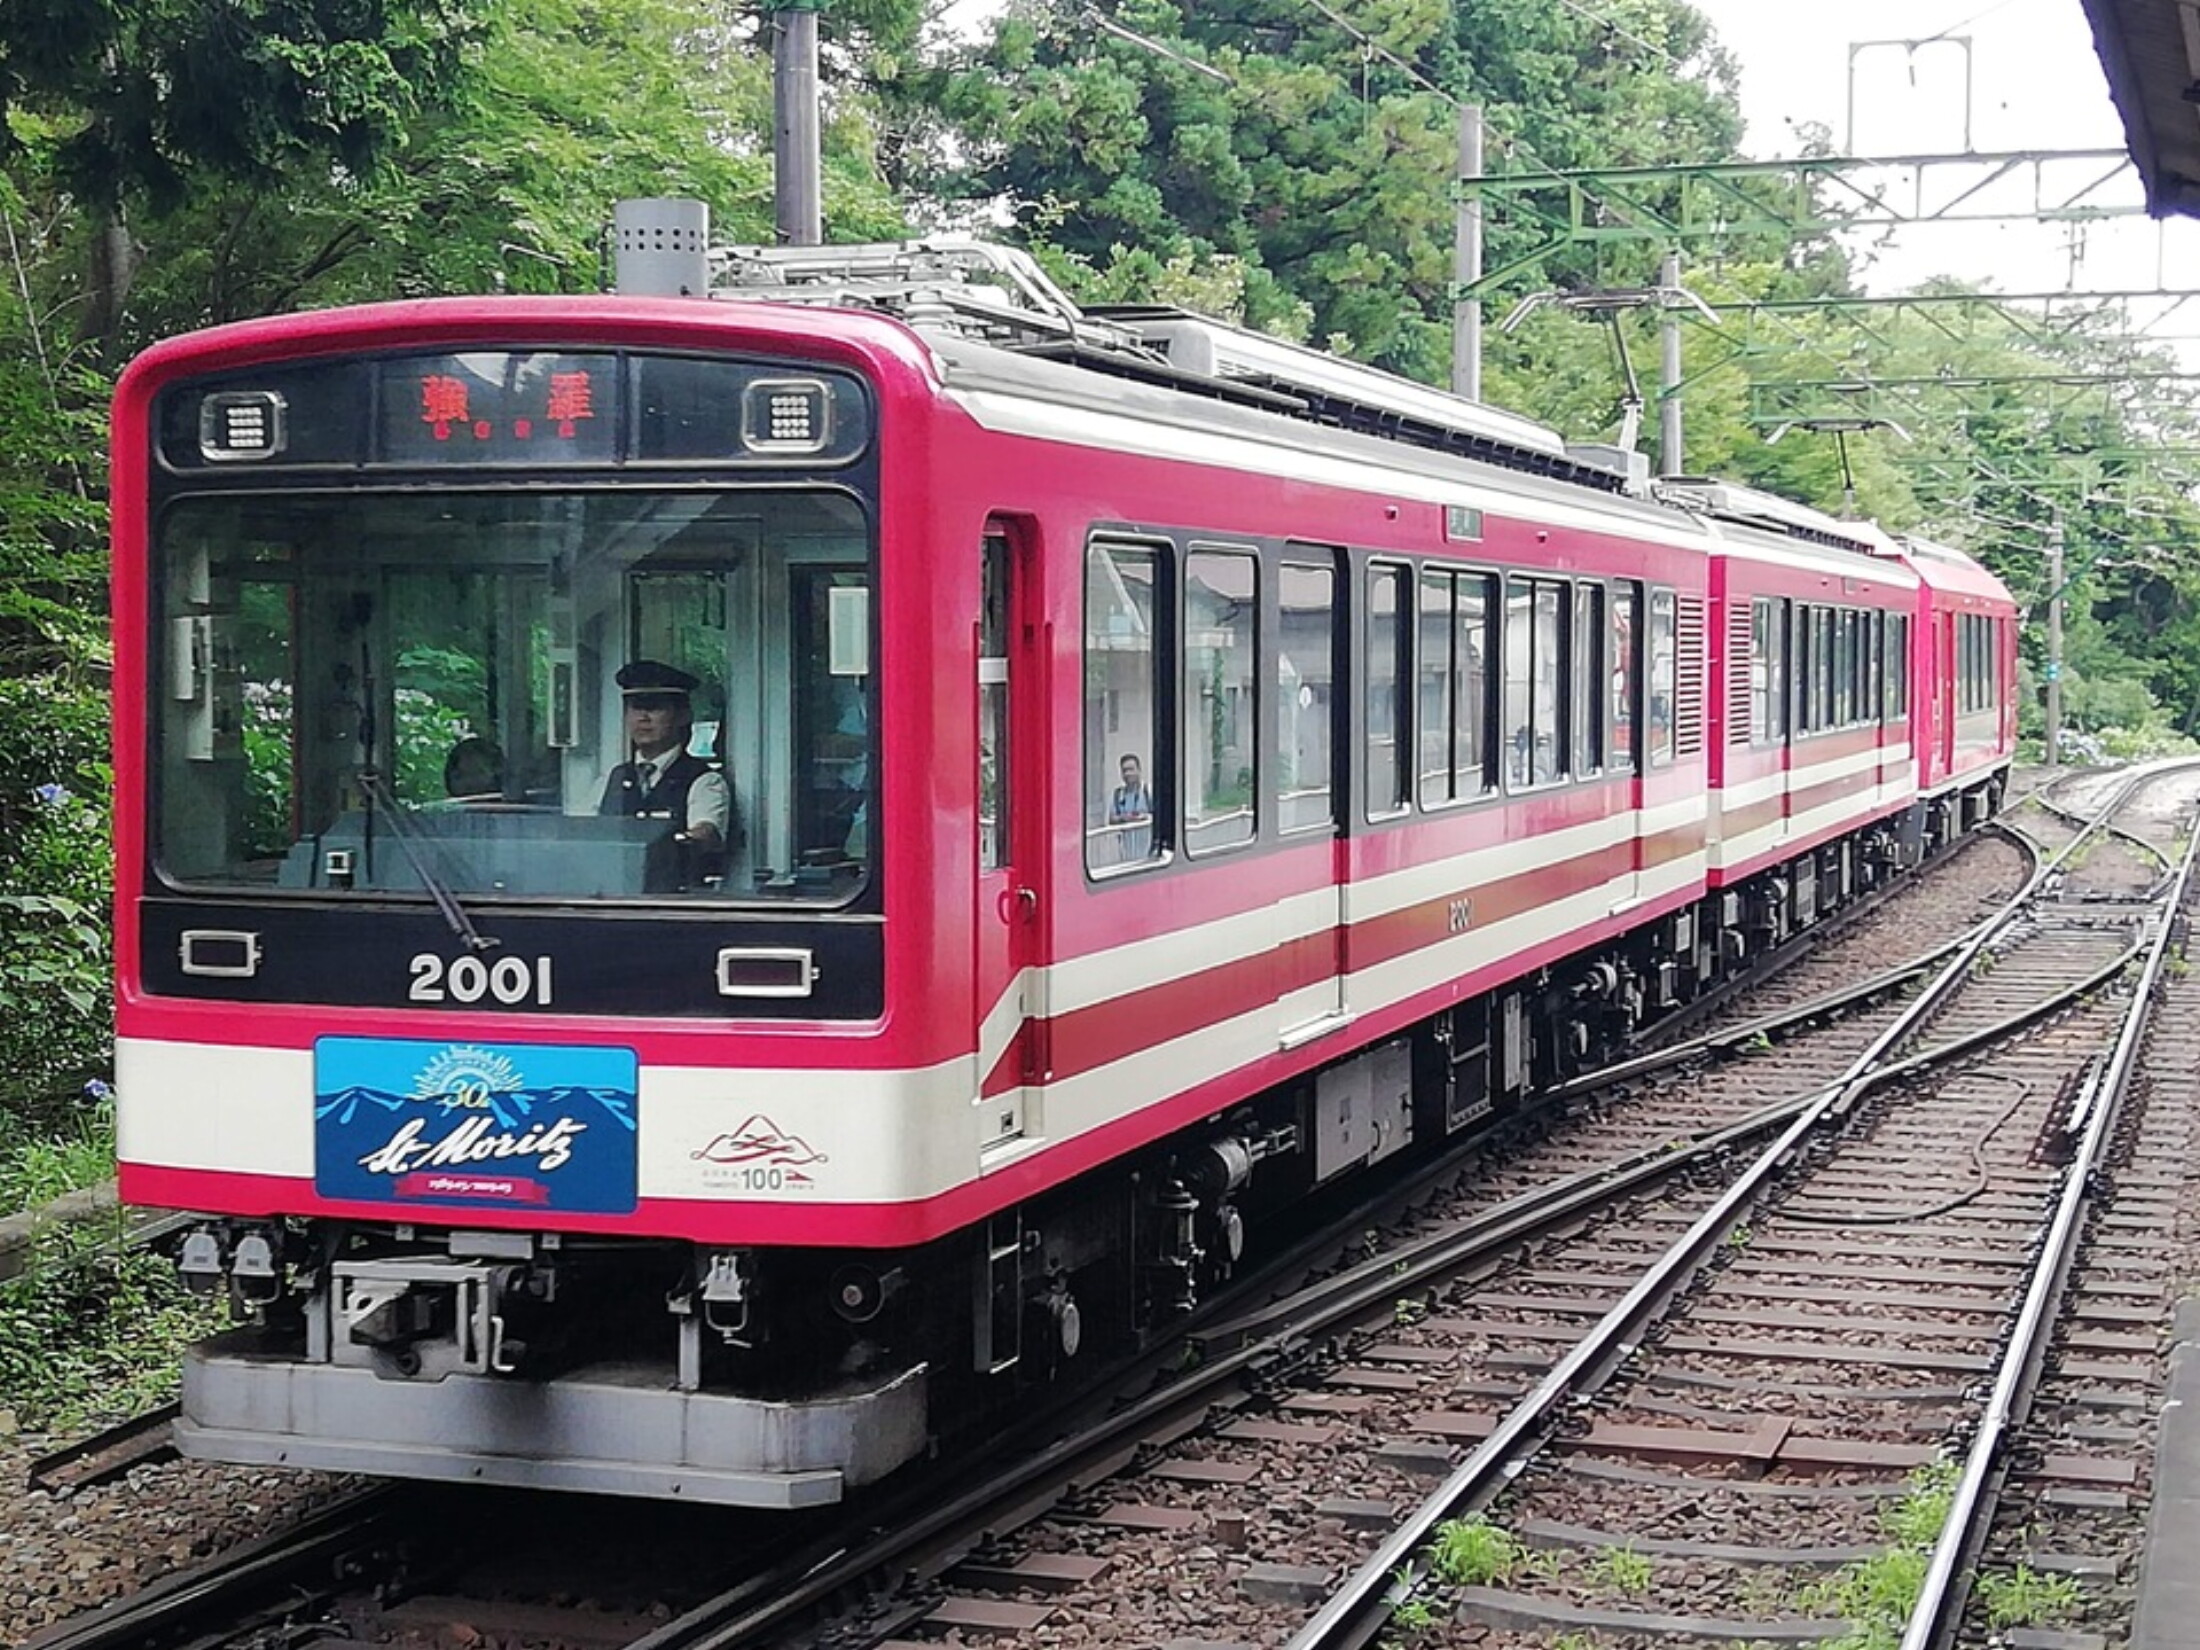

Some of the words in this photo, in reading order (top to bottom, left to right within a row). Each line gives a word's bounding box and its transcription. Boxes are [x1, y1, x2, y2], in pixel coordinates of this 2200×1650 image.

[408, 953, 551, 1005] 2001
[411, 1115, 588, 1171] Moritz
[741, 1167, 783, 1191] 100
